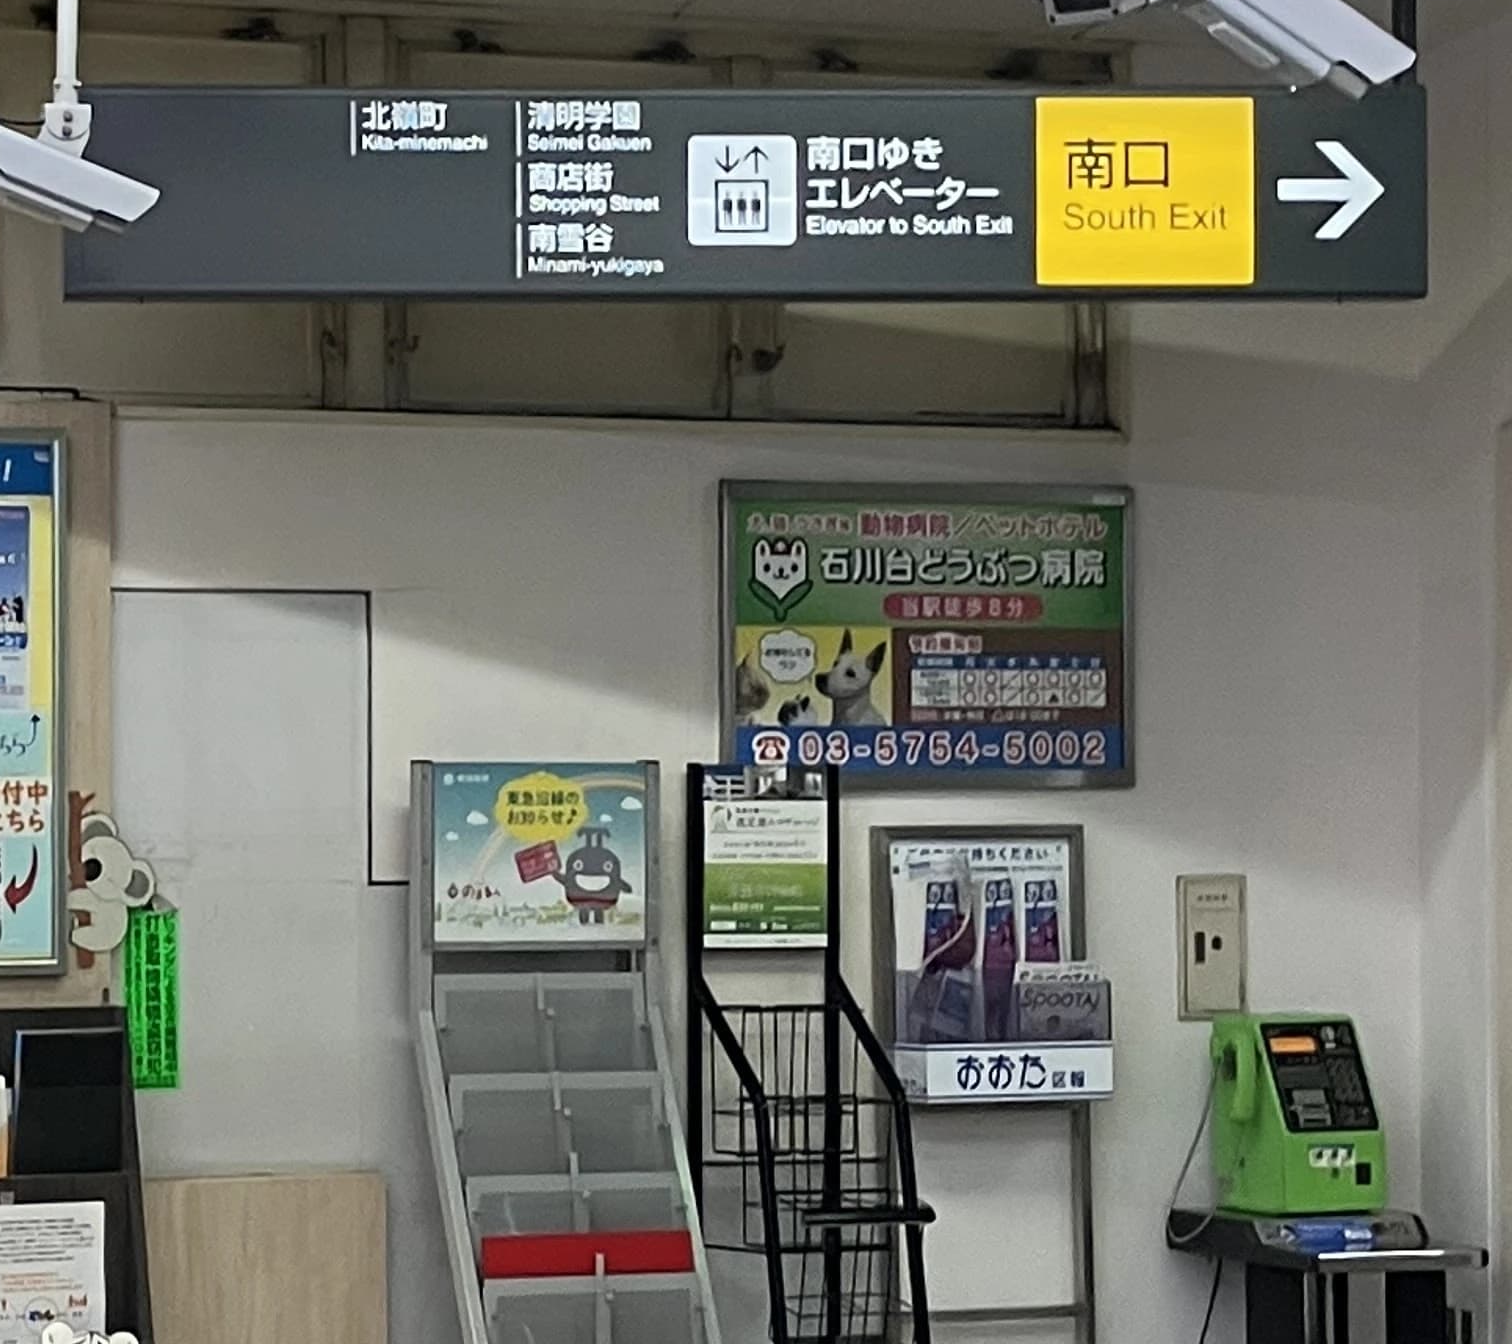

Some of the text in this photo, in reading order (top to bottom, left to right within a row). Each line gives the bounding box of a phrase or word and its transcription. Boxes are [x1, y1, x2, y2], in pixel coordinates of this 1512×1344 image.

[362, 101, 448, 131] 北嶺町
[528, 101, 640, 131] 清明学園
[362, 134, 488, 151] Kita-minemachi
[528, 134, 651, 152] Seimei Gakuen
[806, 136, 944, 172] 南口ゆき
[528, 162, 614, 192] 商店街
[1063, 138, 1171, 189] 南口
[529, 195, 660, 216] Shopping Street
[806, 176, 1000, 211] エレベーター
[806, 215, 1014, 236] Elevator to South Exit
[1063, 203, 1227, 230] South Exit
[528, 223, 614, 253] 南雪谷
[528, 257, 664, 277] Minami-yukigaya
[820, 547, 1107, 587] 石川台どうぶつ病院
[901, 597, 1024, 619] 当駅徒歩8分
[798, 731, 1107, 765] 03-5754-5002
